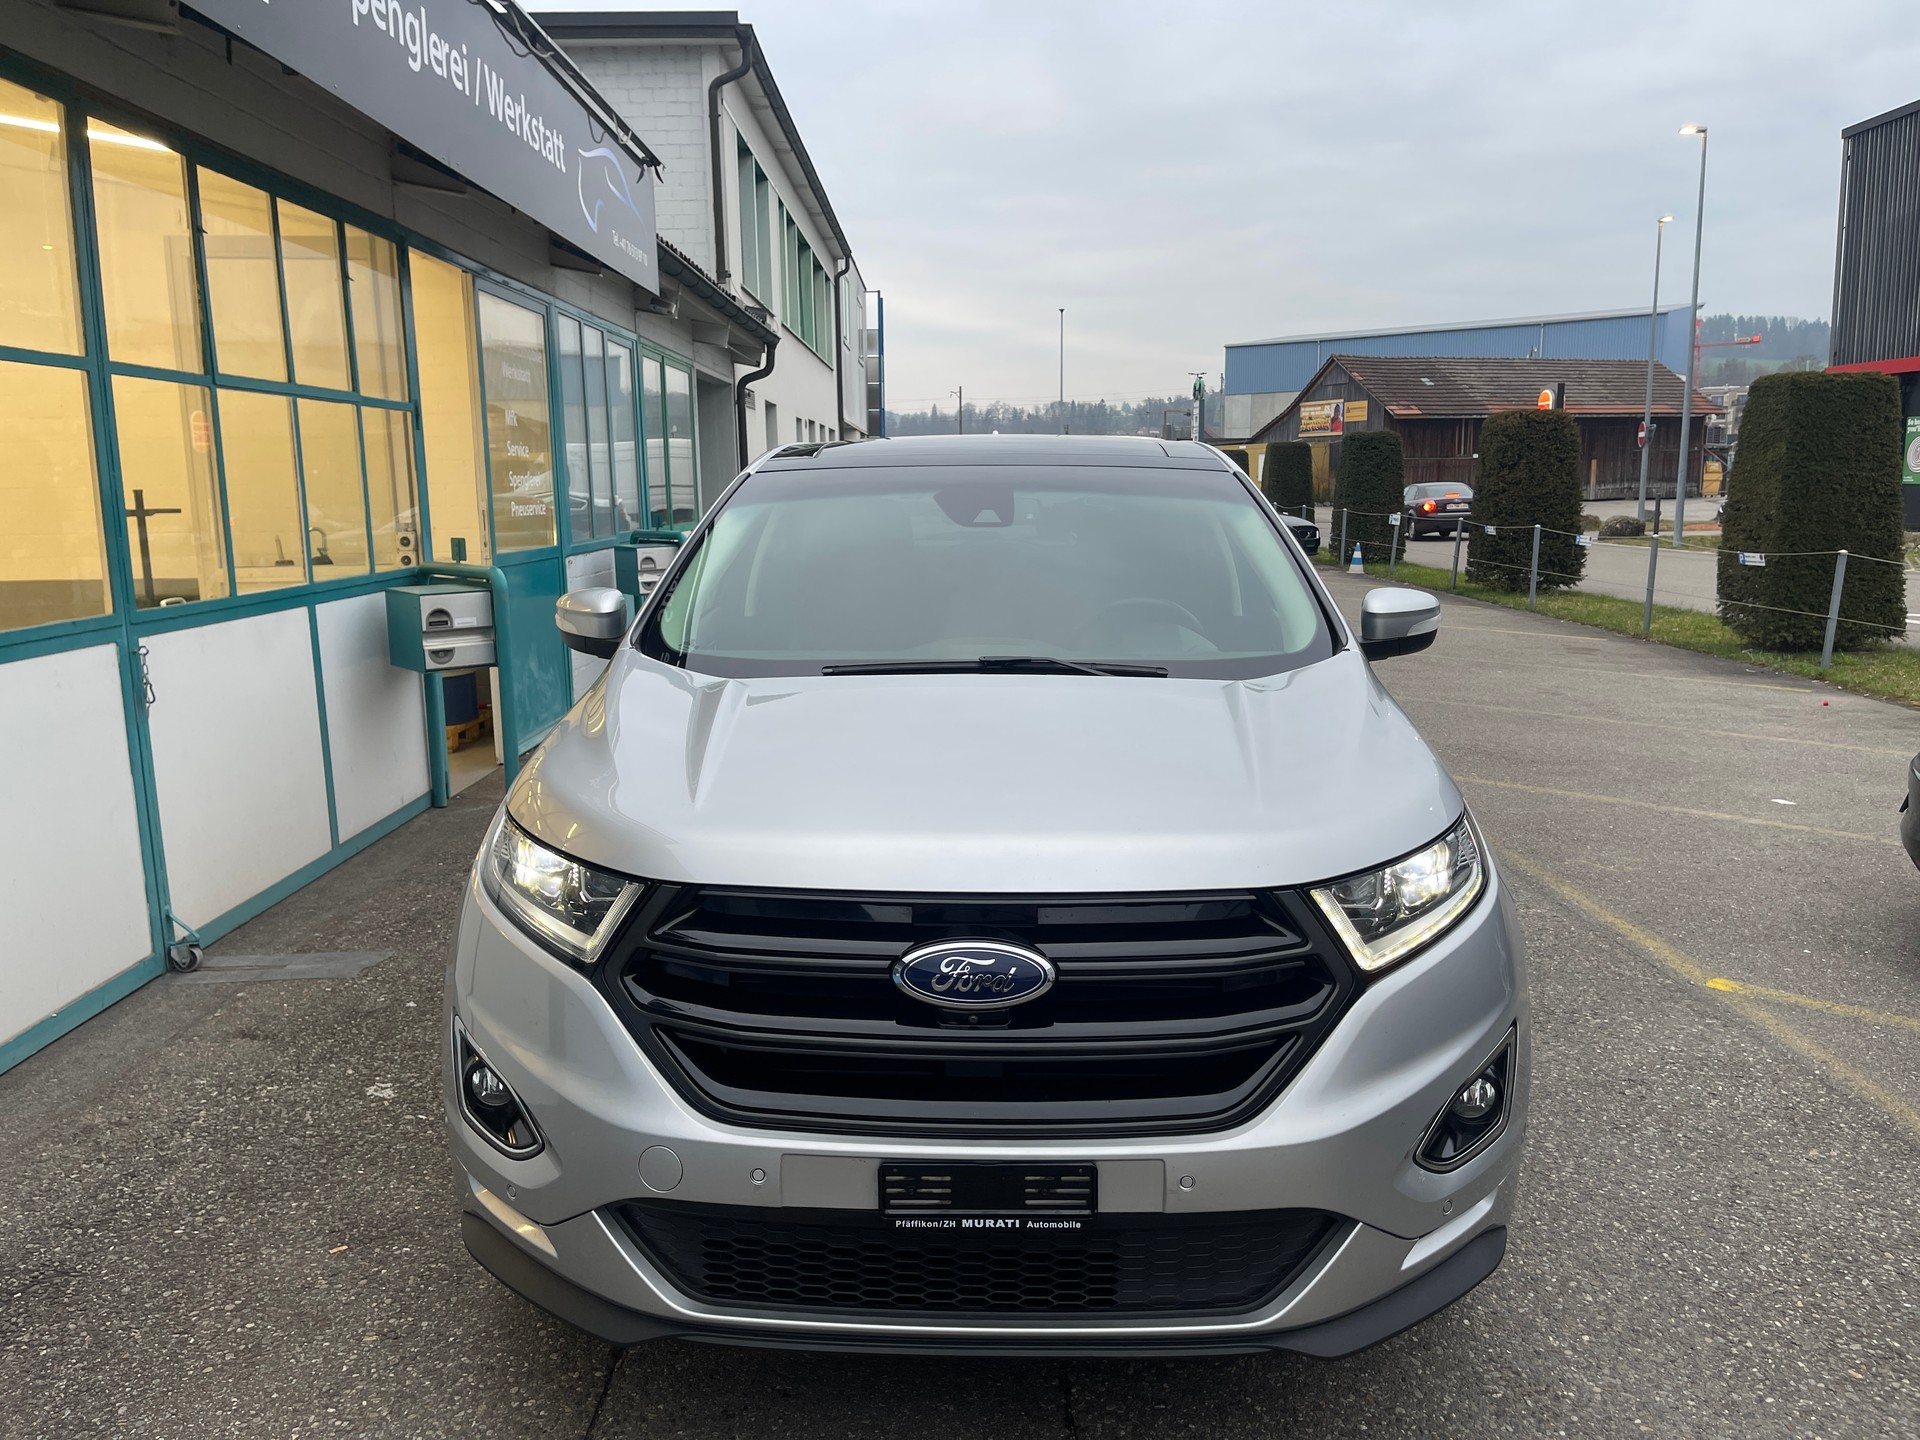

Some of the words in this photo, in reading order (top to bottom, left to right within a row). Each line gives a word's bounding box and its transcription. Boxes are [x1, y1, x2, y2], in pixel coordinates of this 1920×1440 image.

[483, 63, 567, 174] Werkstatt
[507, 441, 529, 457] Service
[511, 502, 546, 517] Pneuservice
[931, 957, 1017, 993] Ford
[895, 1220, 956, 1228] Pfäffikon/ZH
[961, 1219, 1020, 1228] MURATI
[1026, 1221, 1081, 1229] Automobile
